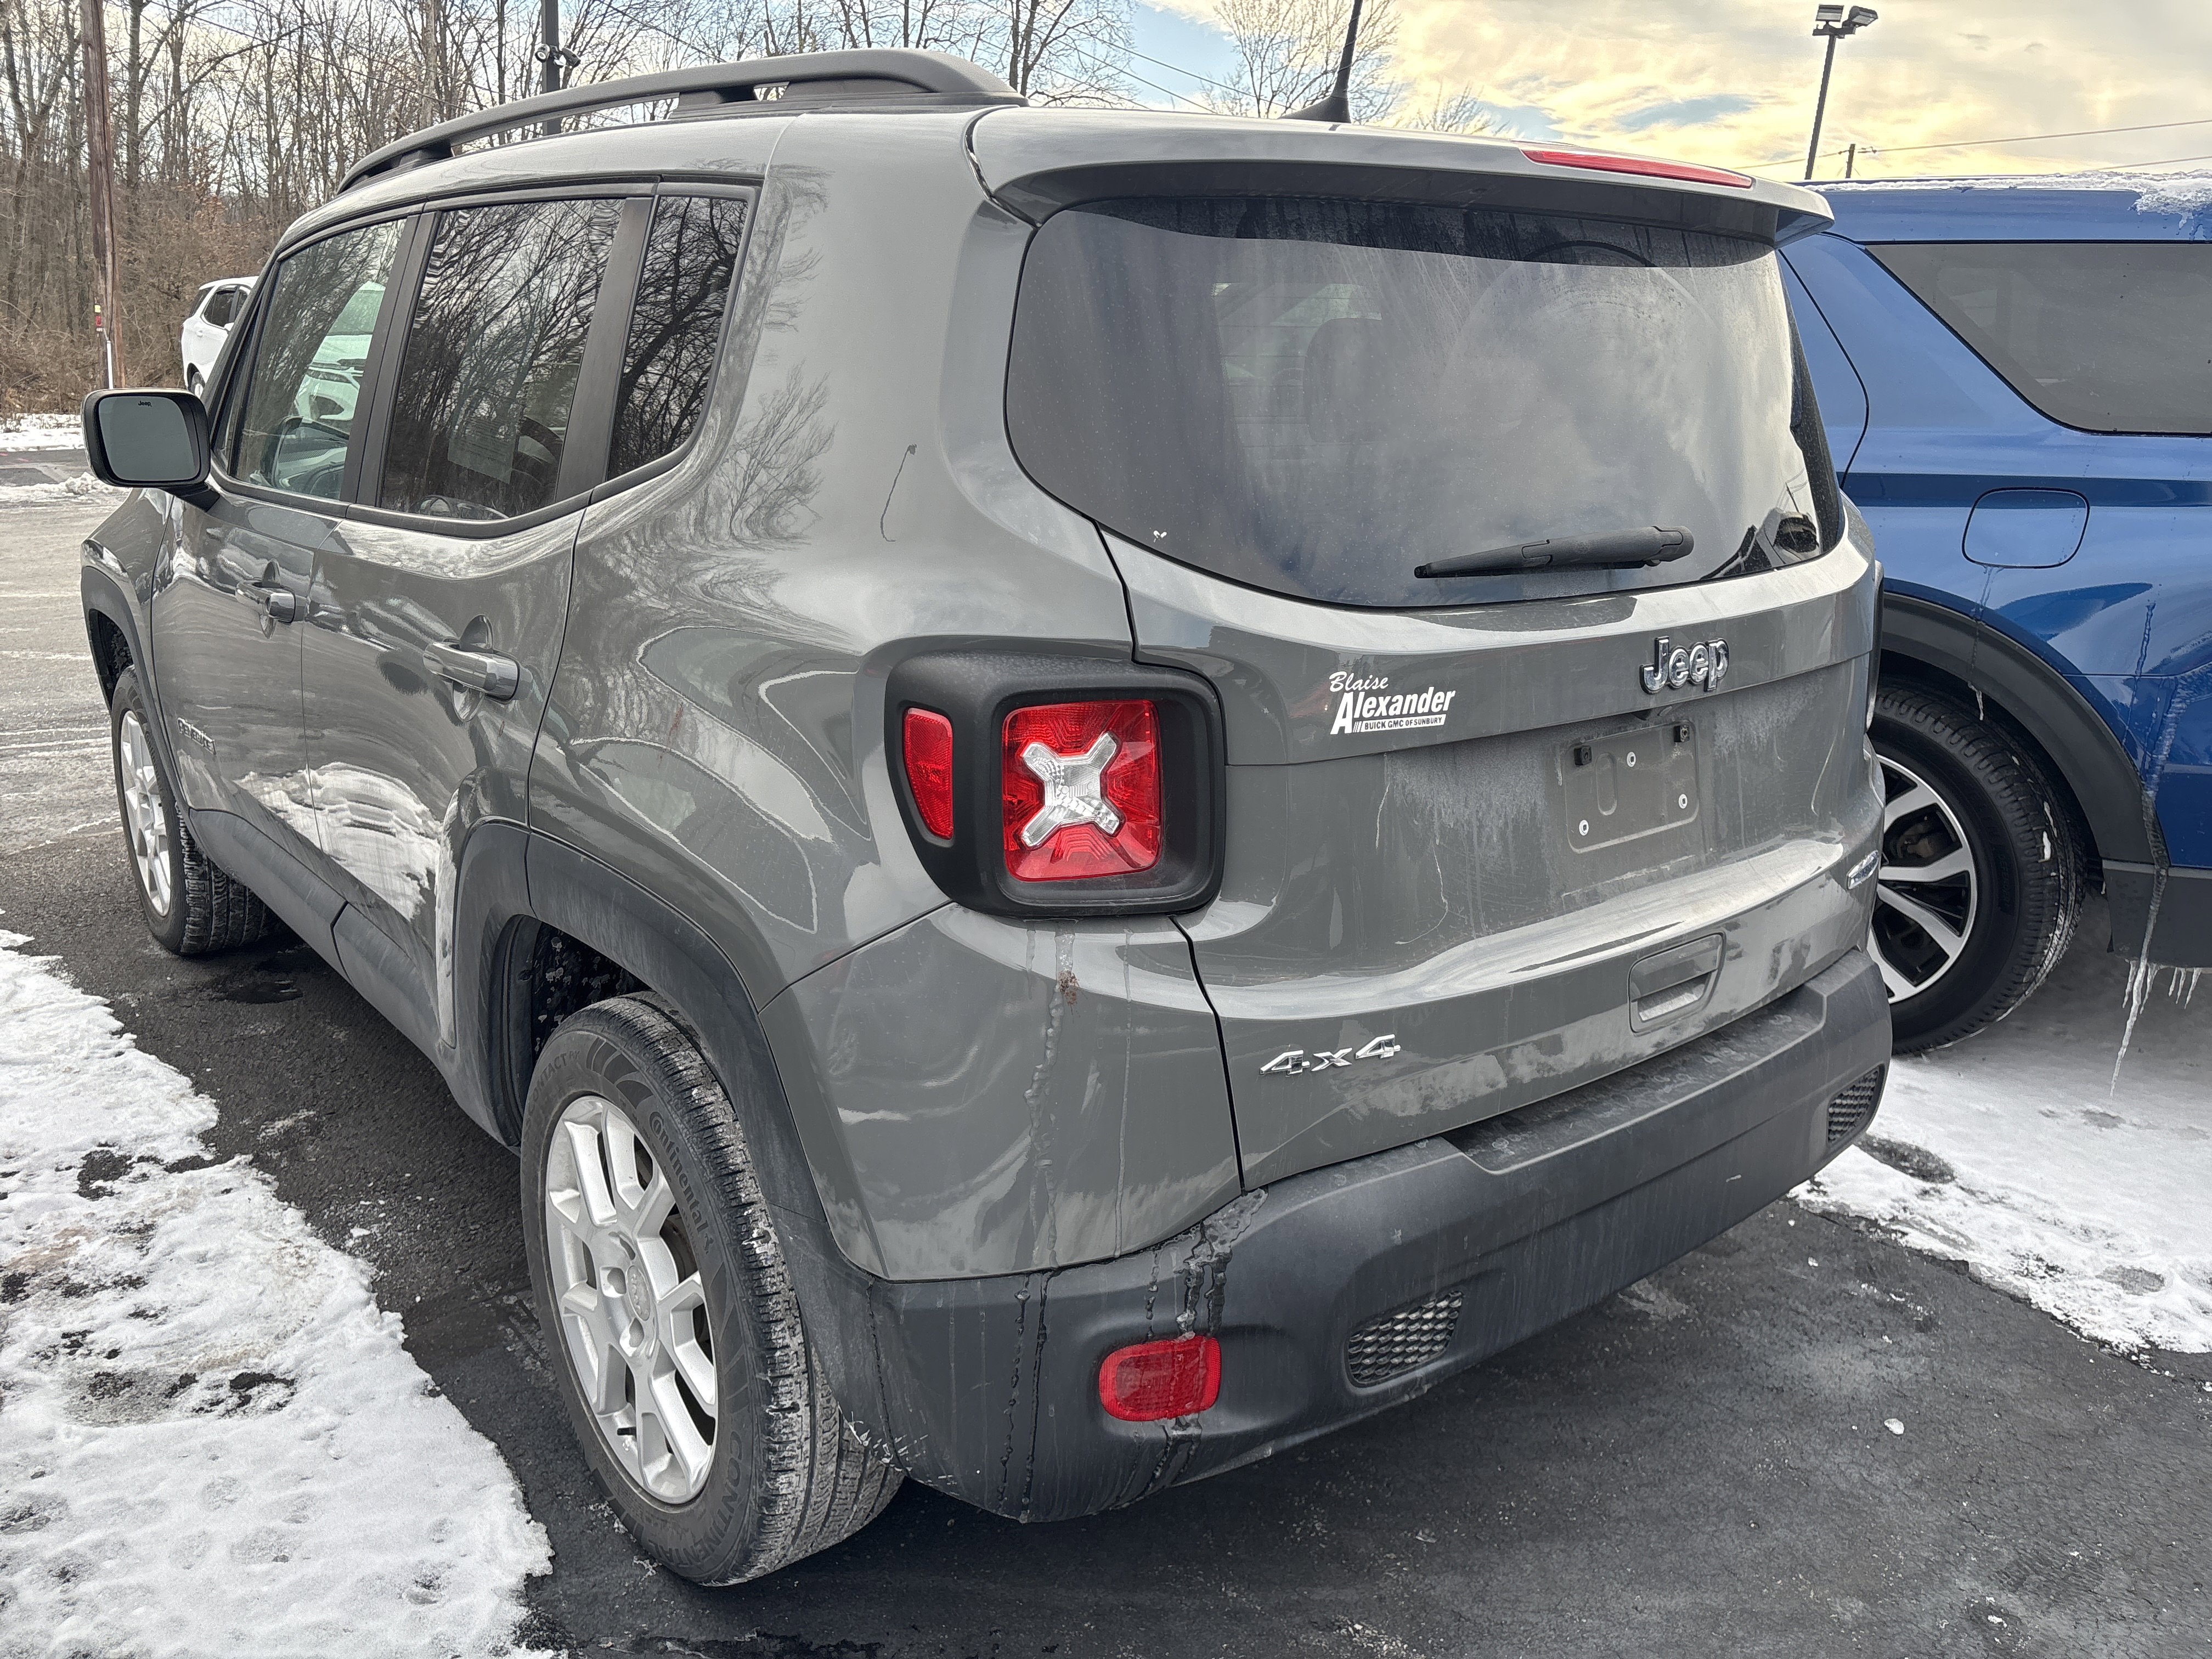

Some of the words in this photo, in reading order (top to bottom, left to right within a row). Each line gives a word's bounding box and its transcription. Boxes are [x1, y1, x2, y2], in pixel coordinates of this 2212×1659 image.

[1329, 671, 1389, 692] Blaise
[1639, 636, 1729, 692] Jeep
[1330, 686, 1456, 735] Alexander
[1364, 720, 1386, 730] BUICK
[1387, 720, 1404, 728] GMC
[1414, 716, 1442, 726] SUNBURY
[649, 1110, 709, 1234] Continental
[647, 1430, 742, 1565] CONTINENTAL
